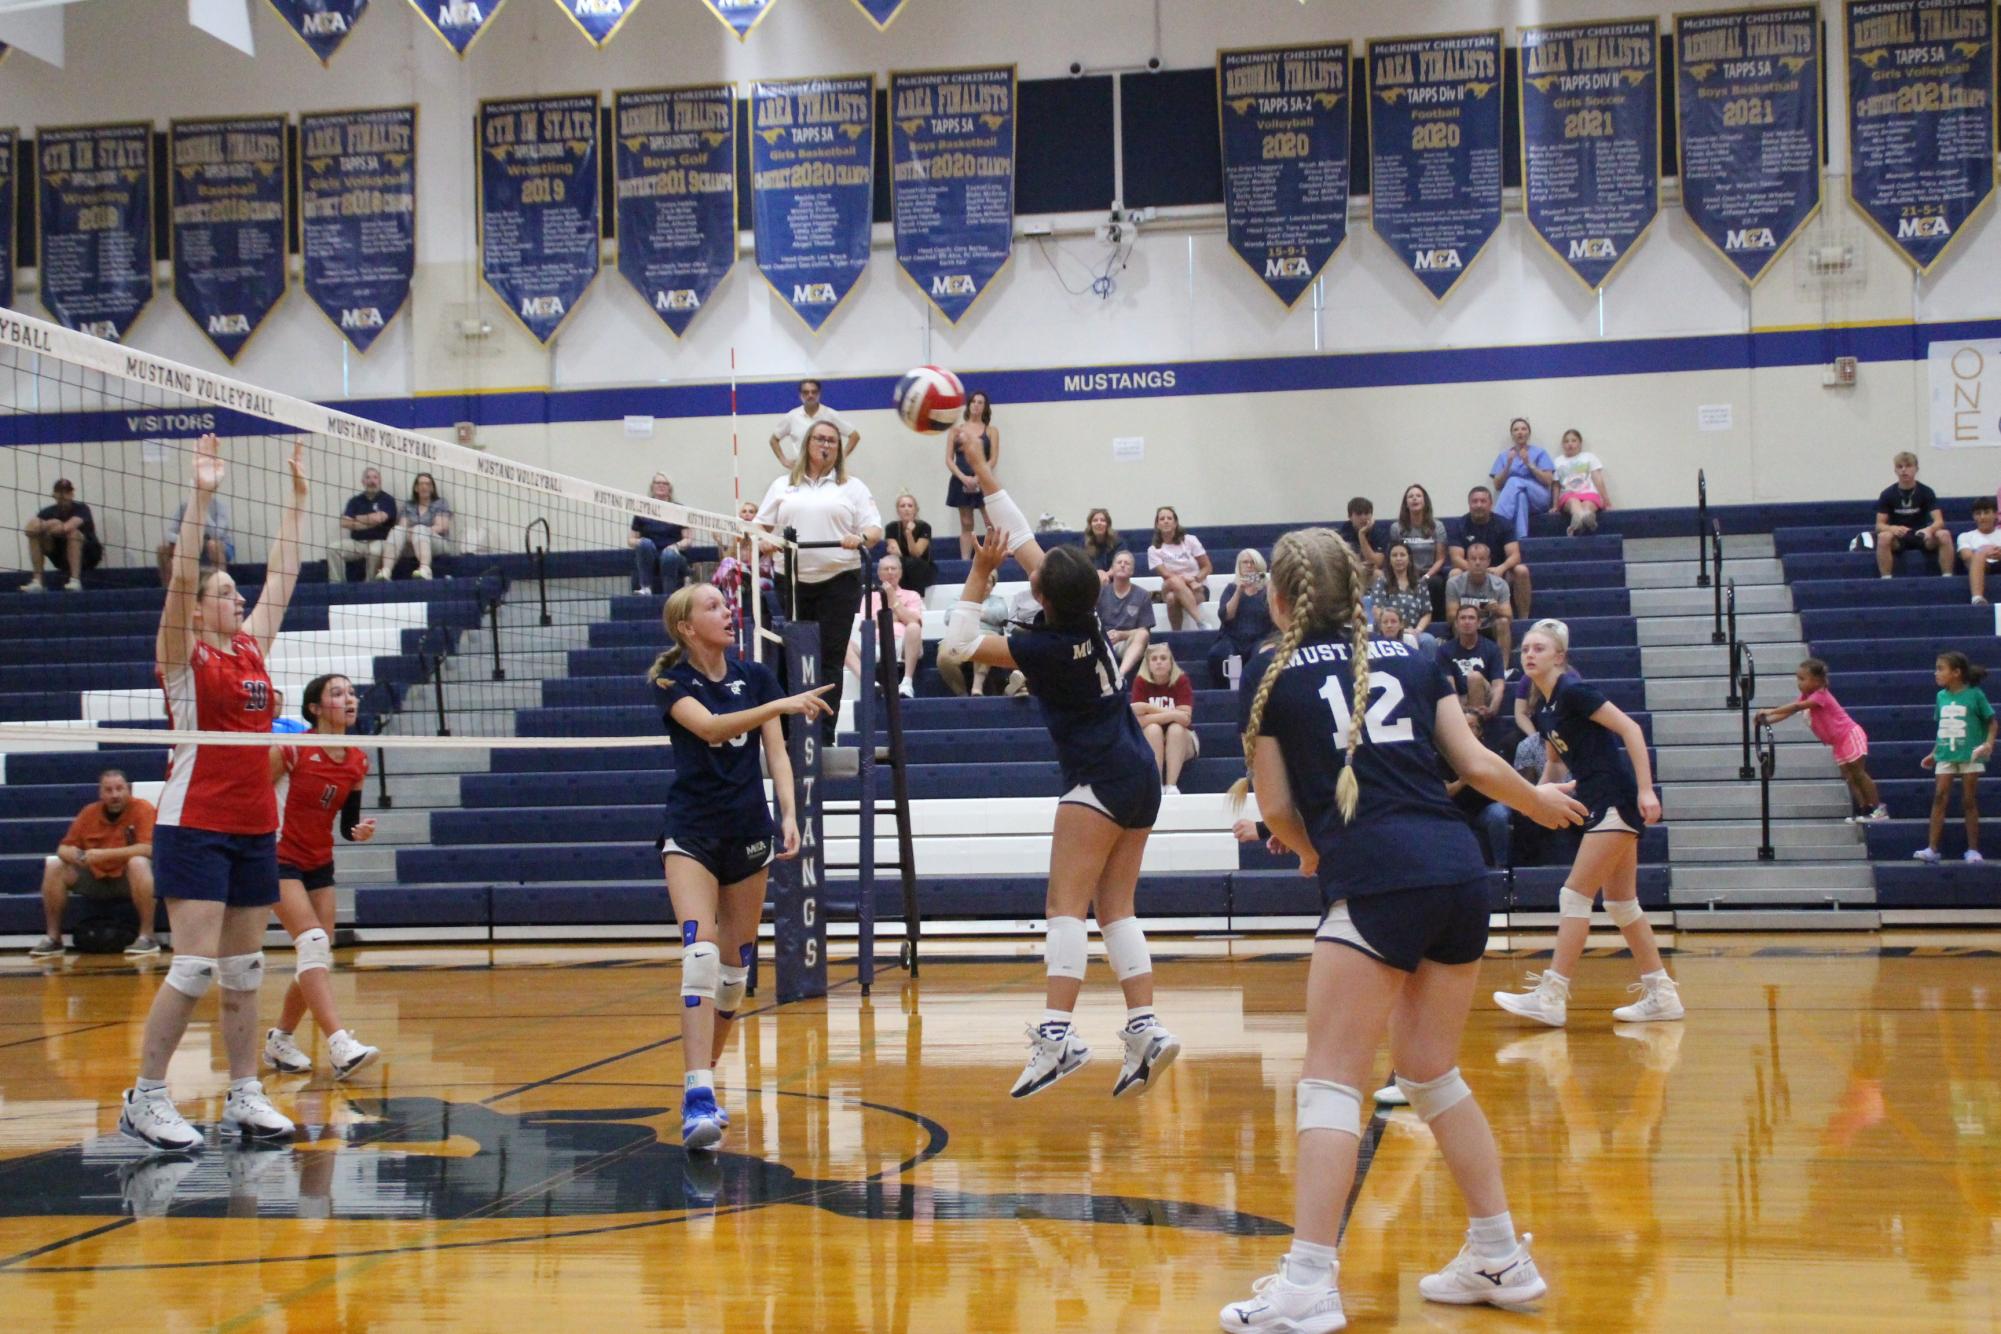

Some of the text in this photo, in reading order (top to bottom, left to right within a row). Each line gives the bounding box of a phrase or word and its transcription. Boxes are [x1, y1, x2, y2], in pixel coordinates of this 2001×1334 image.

[303, 11, 348, 34] MCA
[438, 2, 483, 26] MCA
[1745, 10, 1811, 23] CHRISTIAN
[1587, 23, 1650, 37] CHRISTIAN
[1854, 9, 1987, 48] REGIONAL FINALISTS
[1433, 37, 1495, 49] CHRISTIAN
[1683, 23, 1812, 62] REGIONAL FINALISTS
[1283, 48, 1343, 60] CHRISTIAN
[1527, 36, 1651, 75] AREA FINALISTS
[1894, 46, 1946, 64] TAPPS 5A
[950, 71, 1009, 83] CHRISTIAN
[1375, 48, 1496, 85] AREA FINALISTS
[1722, 61, 1772, 79] TAPPS 5A
[1871, 63, 1970, 80] Girls Volleyball
[1226, 60, 1344, 96] REGIONAL FINALISTS
[1560, 75, 1591, 91] TAPPS
[1592, 72, 1612, 89] DIV
[673, 87, 730, 101] CHRISTIAN
[897, 82, 1009, 118] AREA FINALISTS
[1407, 87, 1438, 103] TAPPS
[1439, 85, 1456, 102] Div
[1697, 80, 1799, 99] Boys Basketball
[1896, 81, 1953, 113] 2021
[757, 91, 869, 127] AREA FINALISTS
[1258, 96, 1313, 114] TAPPS 5A-2
[1411, 107, 1460, 119] Football
[1552, 95, 1626, 109] Girls Soccer
[1722, 98, 1775, 127] 2021
[543, 110, 593, 140] STATE
[673, 101, 730, 132] FINALISTS
[930, 118, 961, 135] TAPPS
[1257, 116, 1315, 130] Volleyball
[1564, 109, 1614, 138] 2021
[790, 126, 820, 143] TAPPS
[937, 136, 998, 150] Basketball
[1262, 131, 1310, 159] 2020
[1411, 121, 1461, 150] 2020
[642, 151, 709, 168] Boys Golf
[769, 145, 857, 161] Girls Basketball
[506, 162, 574, 176] Wrestling
[790, 160, 836, 189] 2020
[930, 151, 977, 179] 2020
[521, 176, 566, 205] 2019
[655, 168, 700, 196] 2019
[1724, 227, 1777, 250] MCA
[1896, 216, 1951, 239] MCA
[1413, 248, 1463, 270] MCA
[1567, 237, 1618, 259] MCA
[1264, 256, 1312, 278] MCA
[792, 282, 838, 305] MCA
[931, 273, 977, 295] MCA
[520, 295, 565, 317] MCA
[655, 288, 701, 310] MCA
[208, 313, 251, 334] MCA
[340, 307, 385, 329] MCA
[125, 355, 275, 418] MUSTANG VOLLEYBALL
[1063, 369, 1177, 393] MUSTANGS
[126, 412, 216, 433] VISITORS
[327, 415, 438, 462] MUSTANG VOLLEYBALL
[476, 457, 516, 481] MUSTANG
[1281, 639, 1410, 670] MUSTNGS
[1149, 696, 1177, 713] MCA
[1317, 670, 1416, 750] 12
[801, 655, 818, 968] MSTANGS
